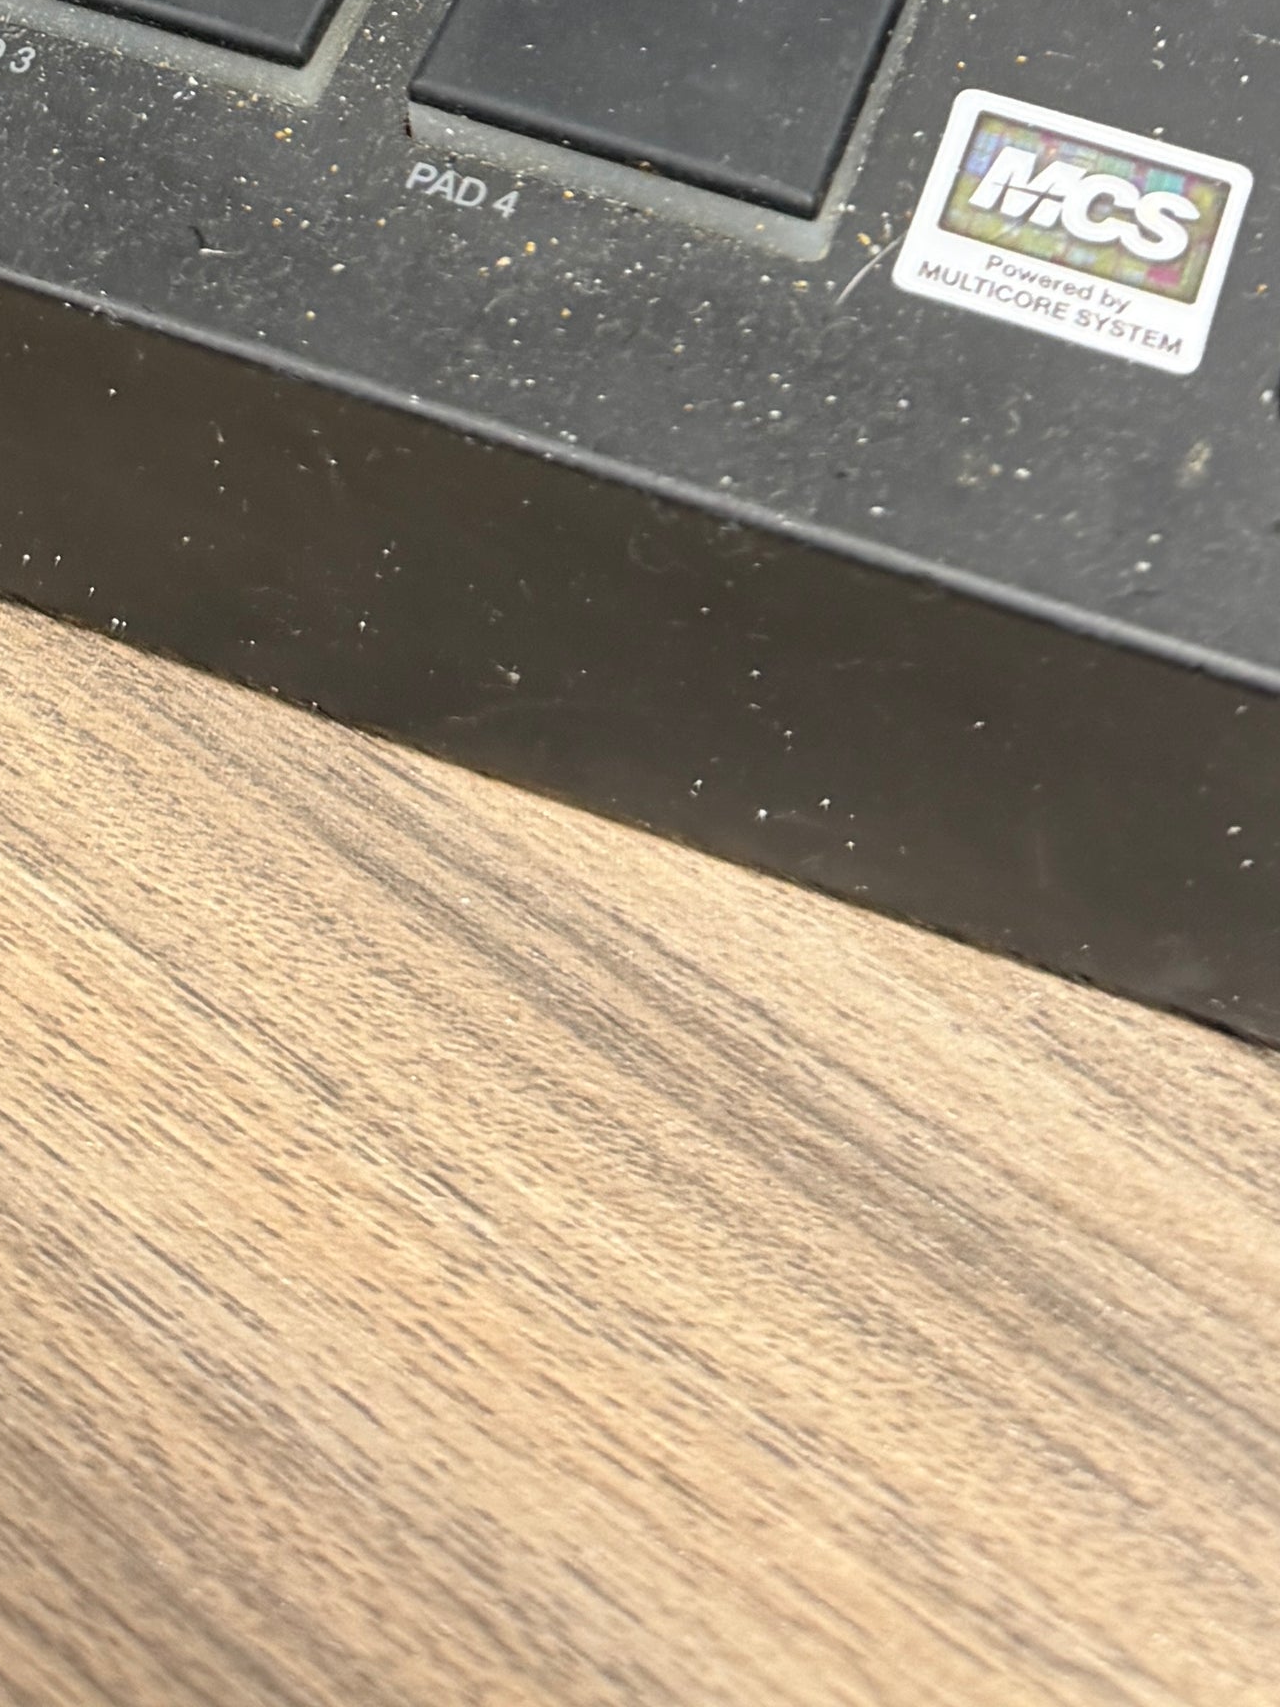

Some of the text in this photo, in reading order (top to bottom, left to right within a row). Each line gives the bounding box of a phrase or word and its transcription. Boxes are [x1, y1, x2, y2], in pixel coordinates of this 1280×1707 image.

[8, 44, 36, 75] 3
[405, 162, 517, 221] PAD 4
[968, 145, 1201, 262] MCS
[916, 258, 1184, 356] MULTICORE SYSTEM
[984, 253, 1133, 317] Powered by
